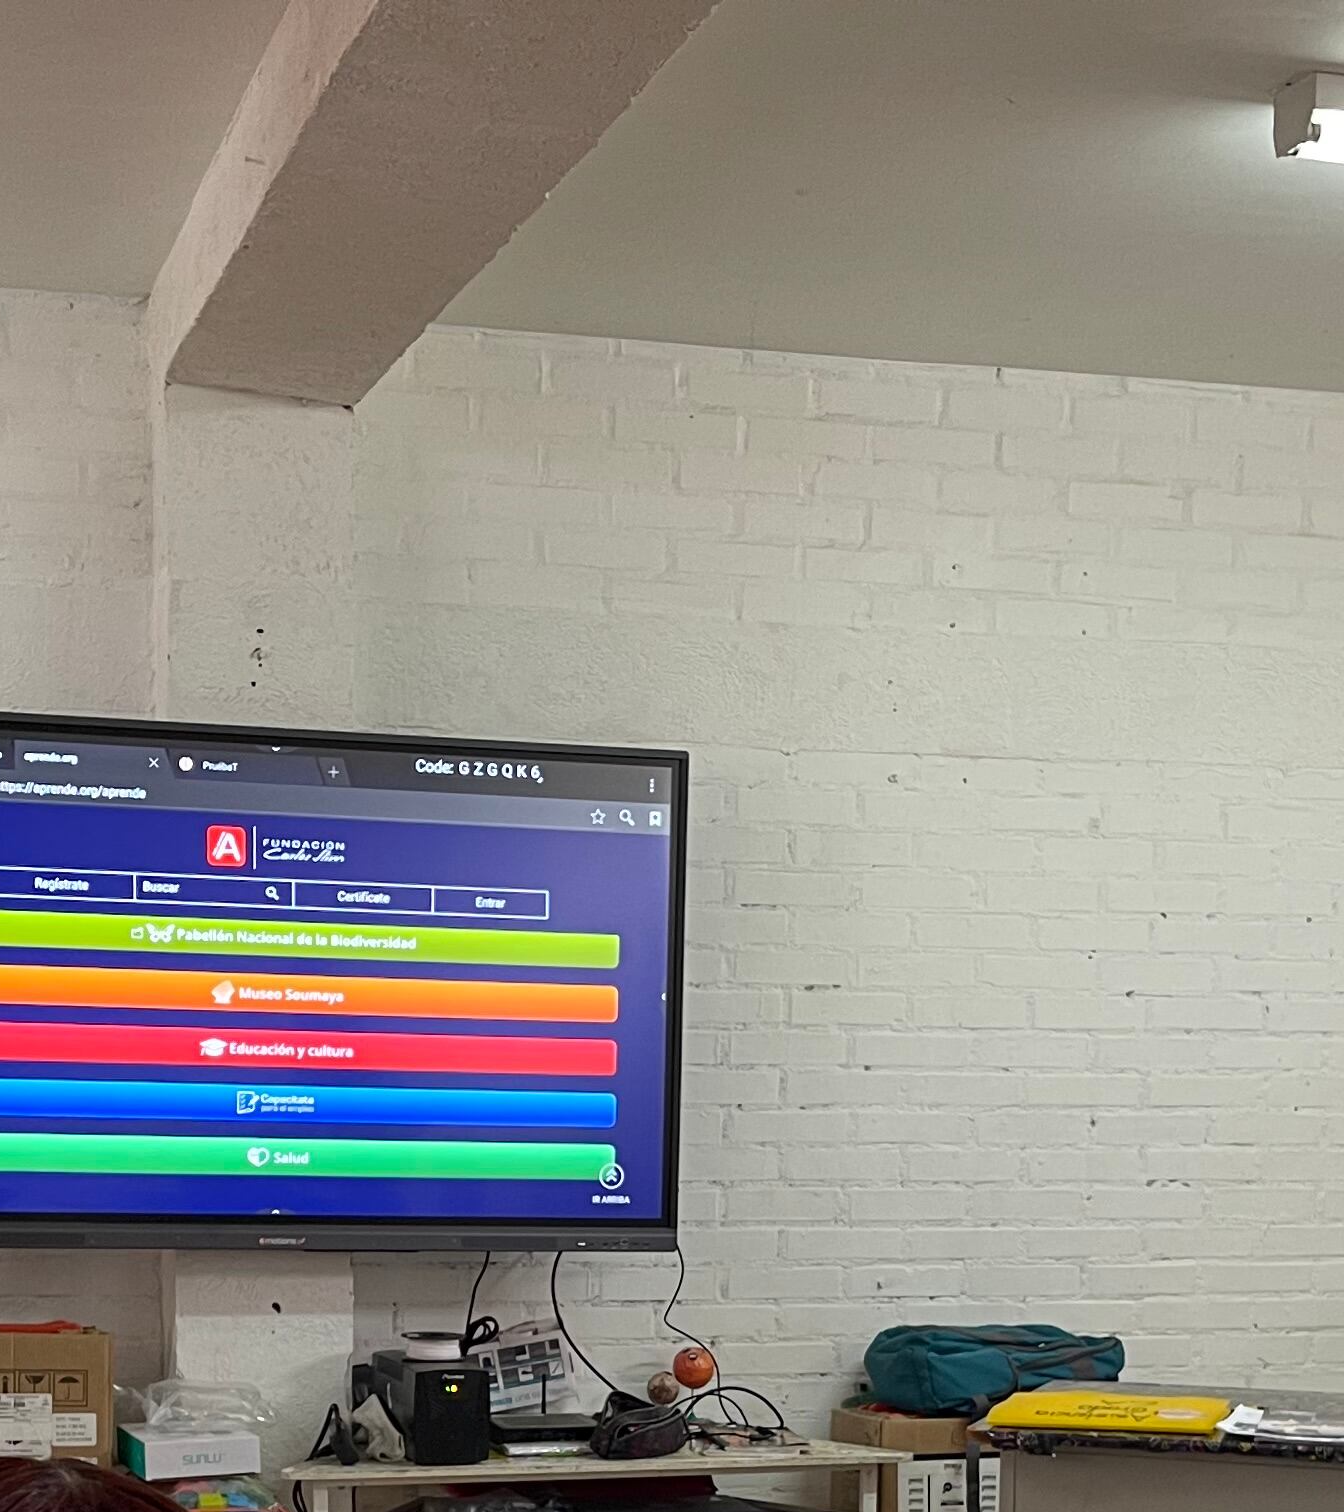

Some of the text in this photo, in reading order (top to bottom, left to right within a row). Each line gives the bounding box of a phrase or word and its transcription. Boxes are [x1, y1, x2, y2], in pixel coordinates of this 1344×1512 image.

[415, 758, 455, 774] Code:
[142, 880, 180, 894] Buscar
[475, 896, 506, 909] Entrar
[176, 928, 417, 949] Pabellón Nacional de la Biodiversidad
[239, 986, 345, 1005] Museo Soumaya
[229, 1041, 354, 1060] Educación y cultura
[273, 1151, 310, 1164] Salud
